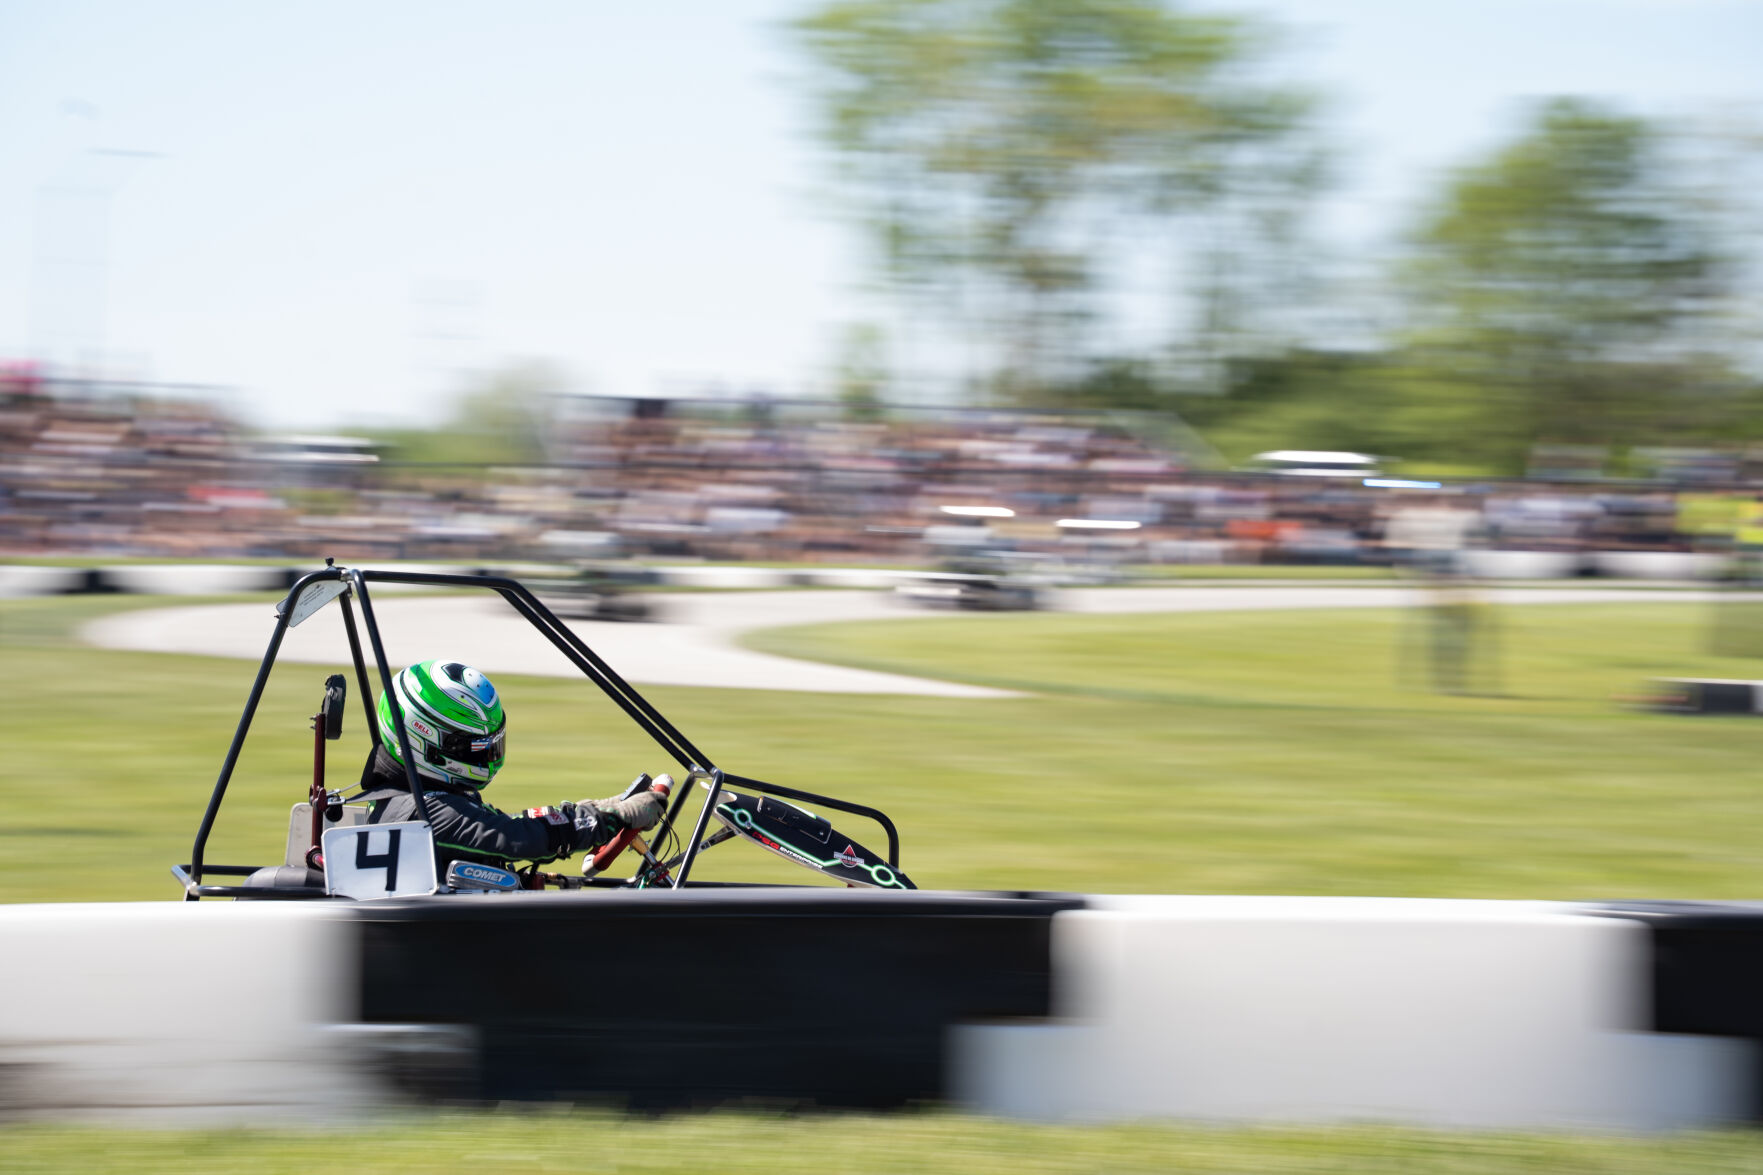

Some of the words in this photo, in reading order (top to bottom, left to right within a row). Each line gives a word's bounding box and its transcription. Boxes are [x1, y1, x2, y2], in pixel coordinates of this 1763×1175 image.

[413, 721, 429, 735] BELL
[355, 829, 402, 891] 4
[463, 867, 506, 882] COMET
